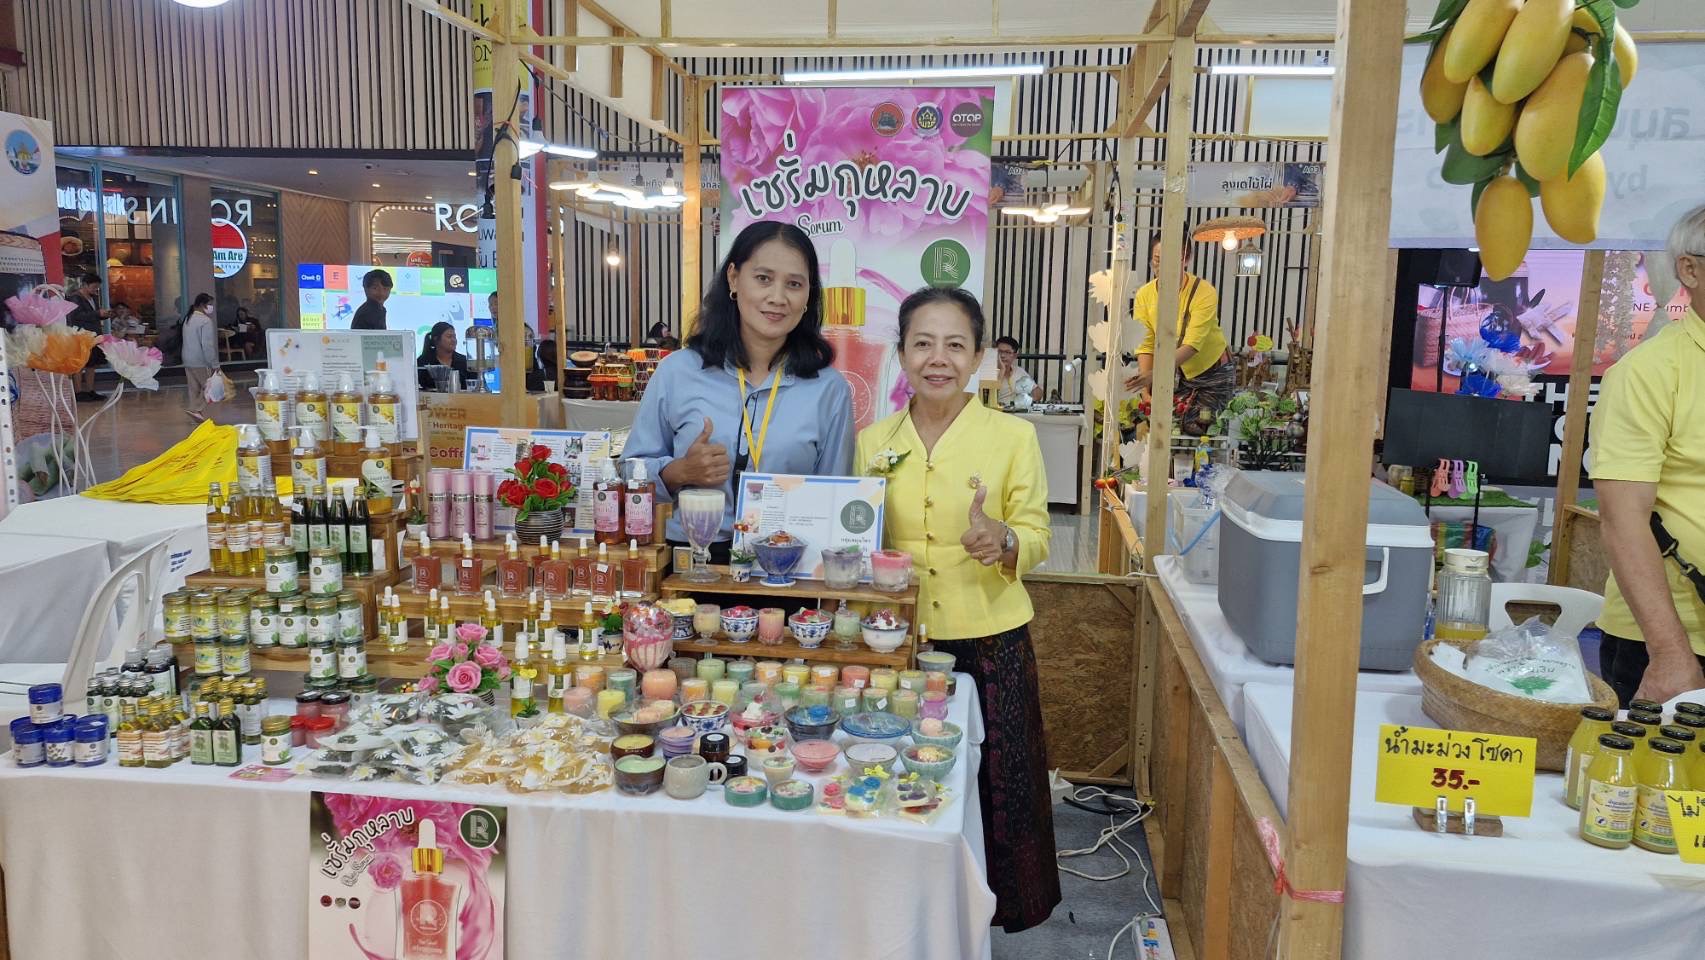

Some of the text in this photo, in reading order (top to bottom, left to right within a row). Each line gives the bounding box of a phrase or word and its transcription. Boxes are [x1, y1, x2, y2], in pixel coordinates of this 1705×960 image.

[952, 113, 981, 123] OTOP
[741, 132, 970, 217] เซรั่มกุหลาบ
[228, 250, 243, 261] Are
[1431, 768, 1480, 790] 35.-
